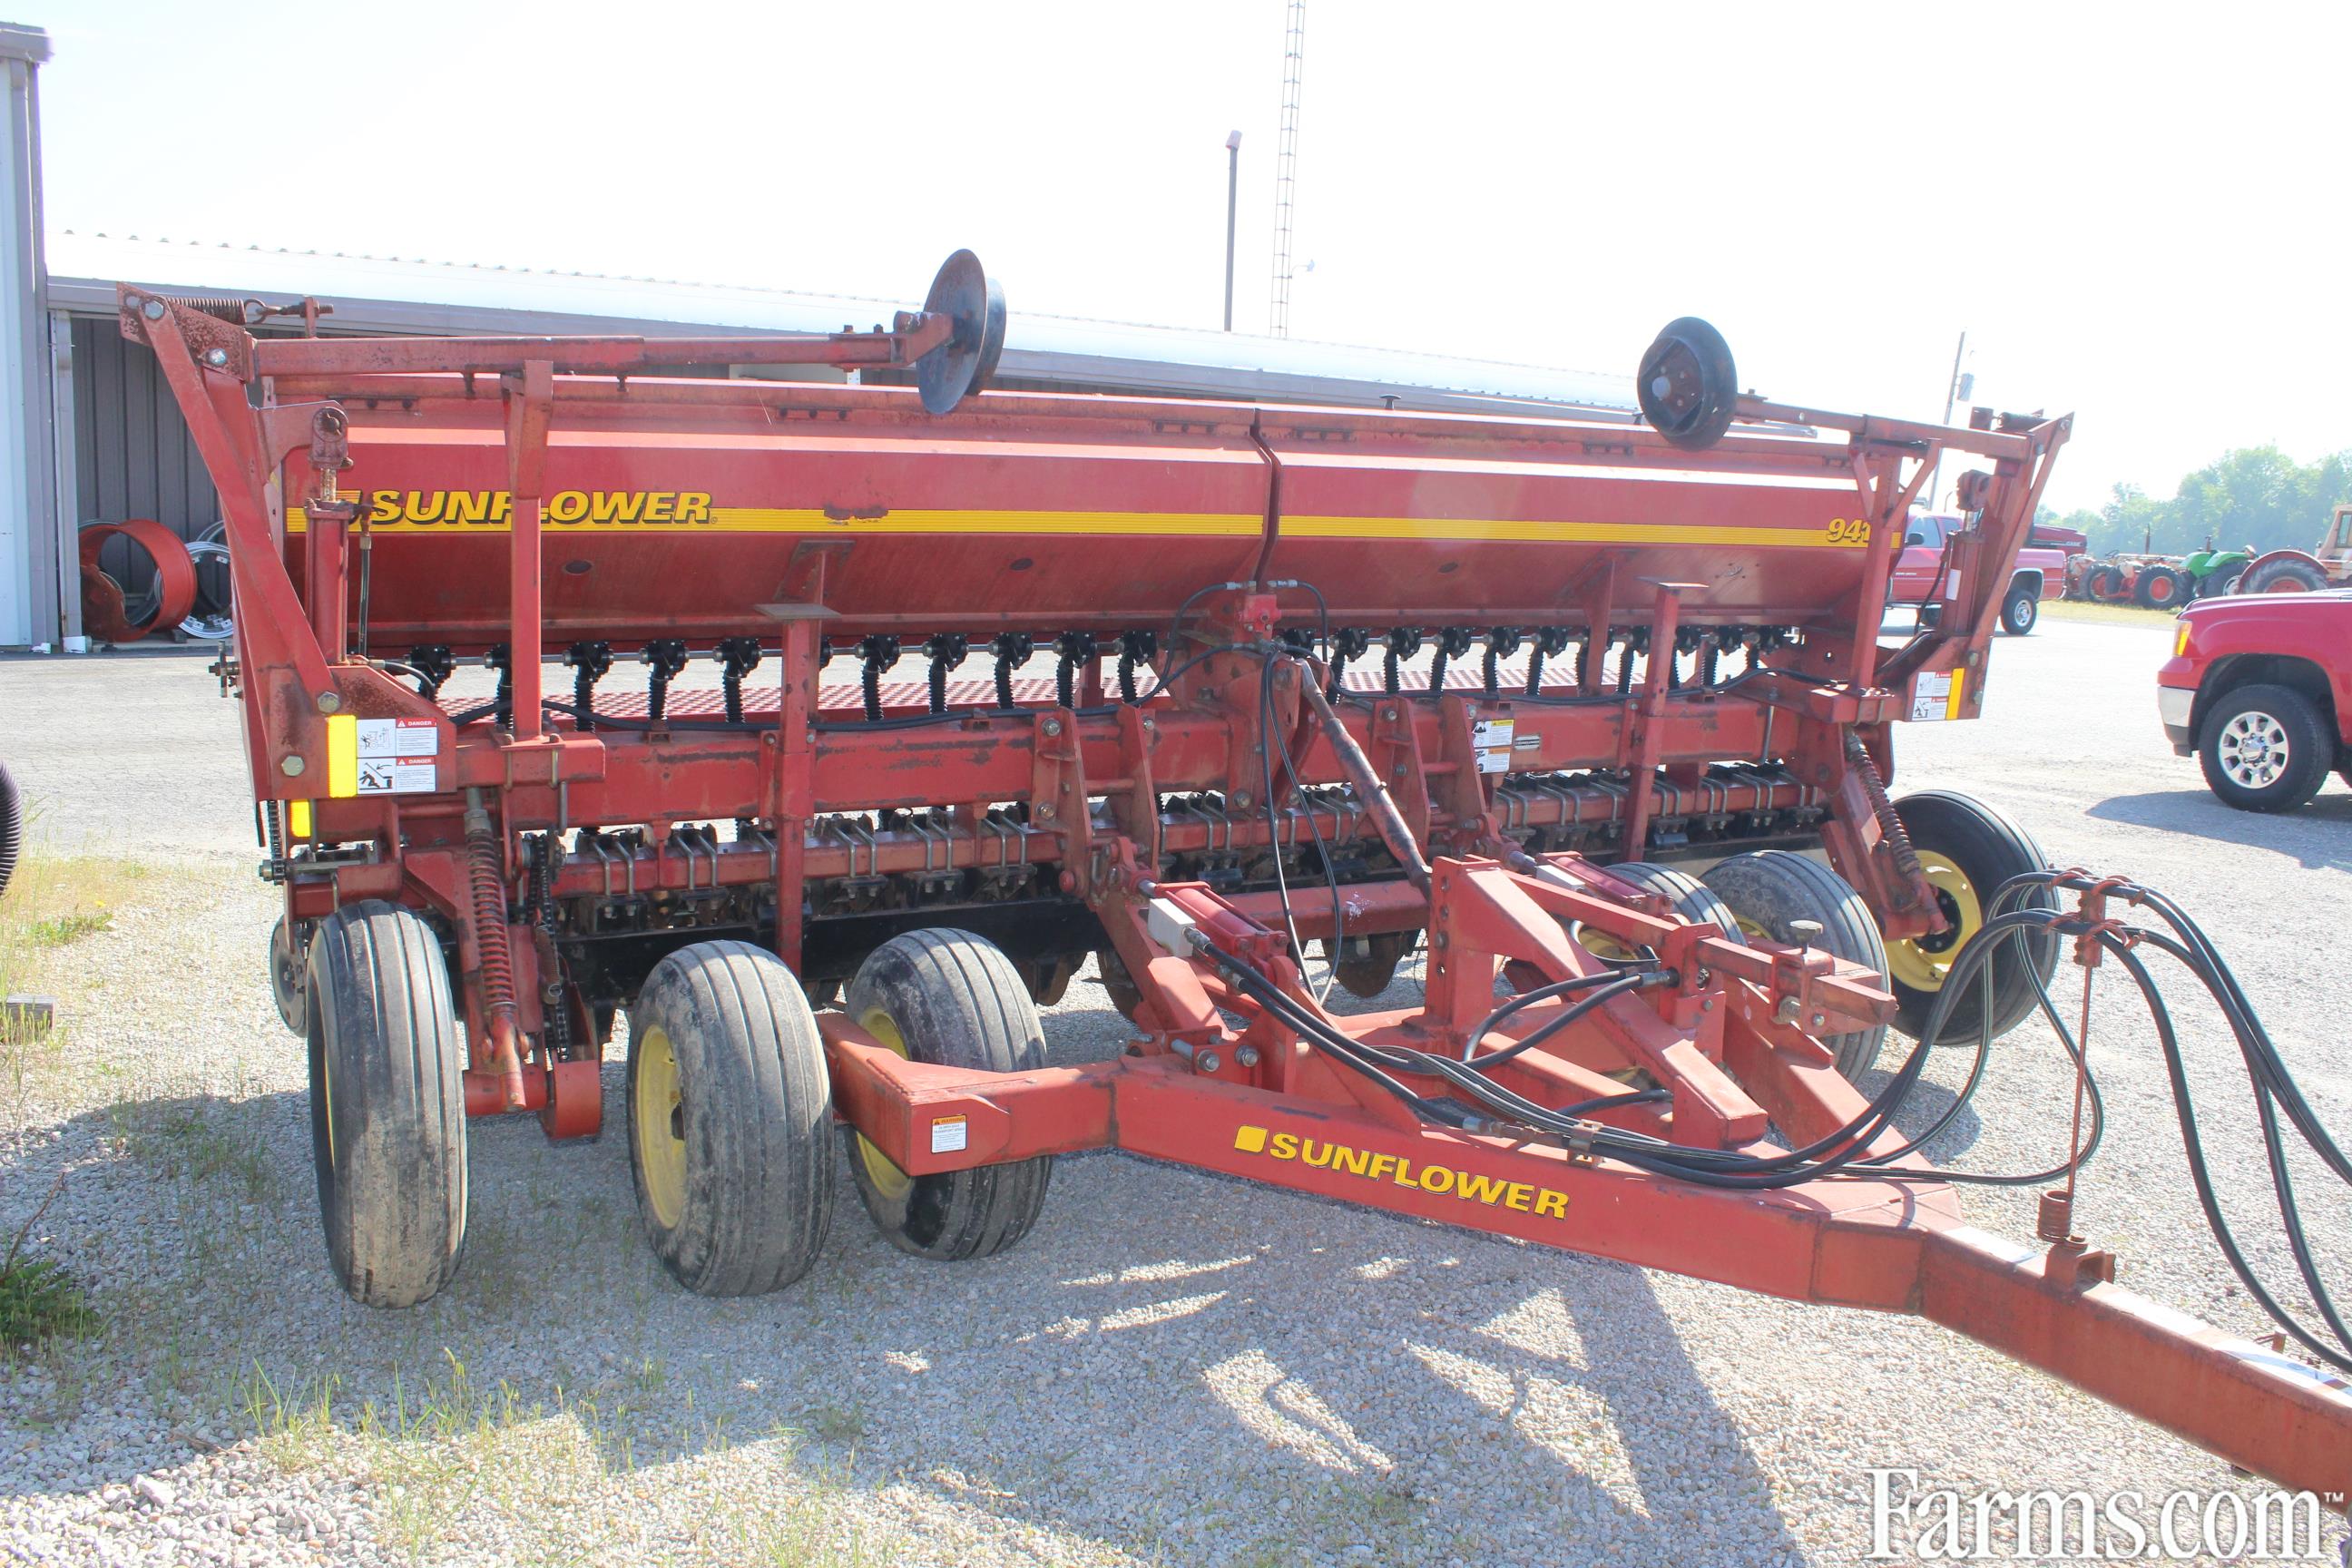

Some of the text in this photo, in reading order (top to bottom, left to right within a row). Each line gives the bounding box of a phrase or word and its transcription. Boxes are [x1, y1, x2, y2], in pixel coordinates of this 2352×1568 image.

[368, 490, 712, 524] SUNFOWER
[1827, 517, 1871, 543] 941
[1270, 1132, 1570, 1220] SUNFLOWER
